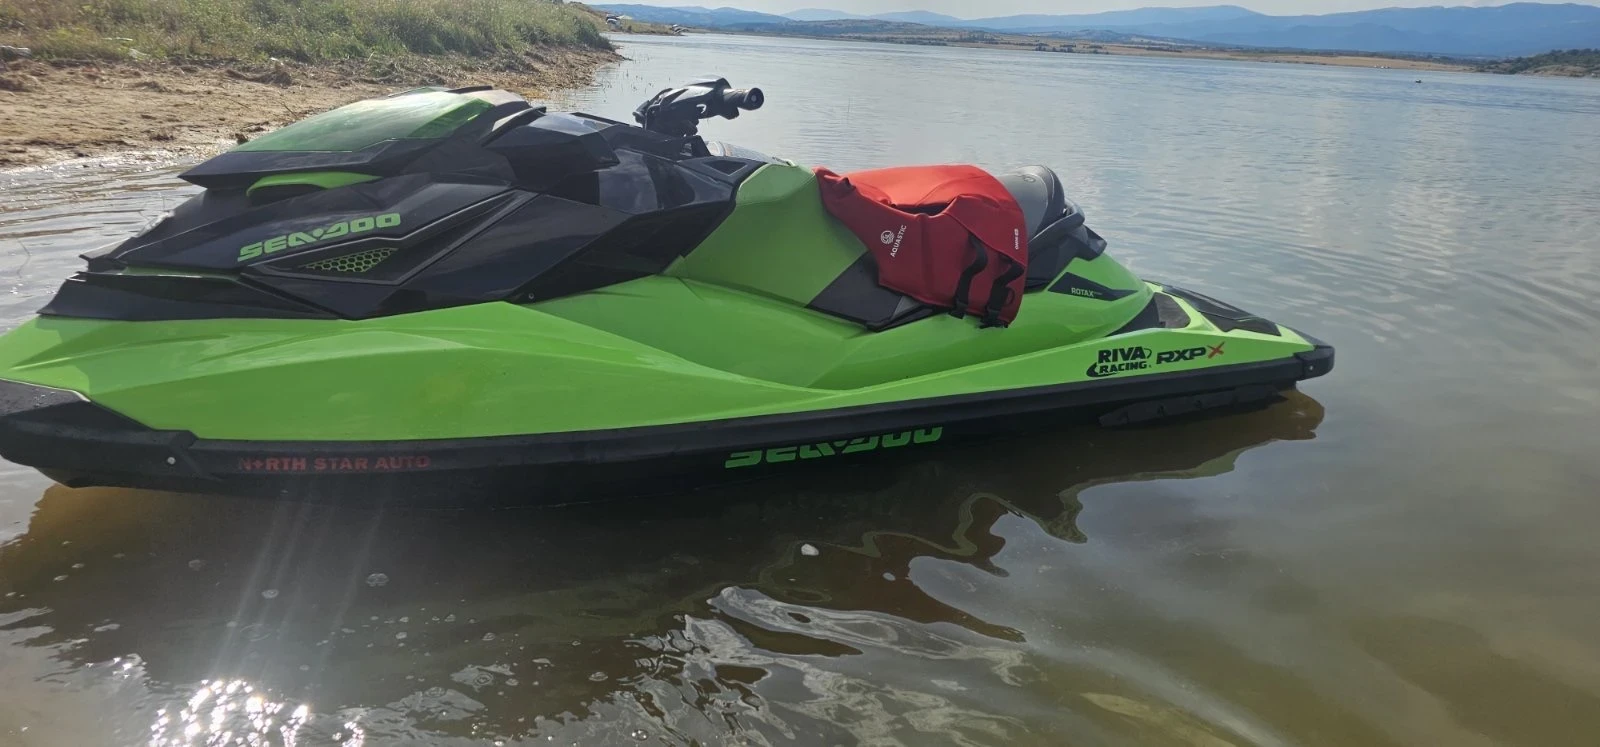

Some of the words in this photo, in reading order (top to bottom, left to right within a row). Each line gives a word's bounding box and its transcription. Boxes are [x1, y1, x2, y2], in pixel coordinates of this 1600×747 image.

[890, 224, 907, 258] AQUASTIC
[1071, 287, 1094, 298] ROTAX
[1098, 346, 1146, 364] RIVA
[1099, 360, 1148, 375] RACING
[314, 457, 369, 471] STAR
[375, 455, 431, 470] AUTO
